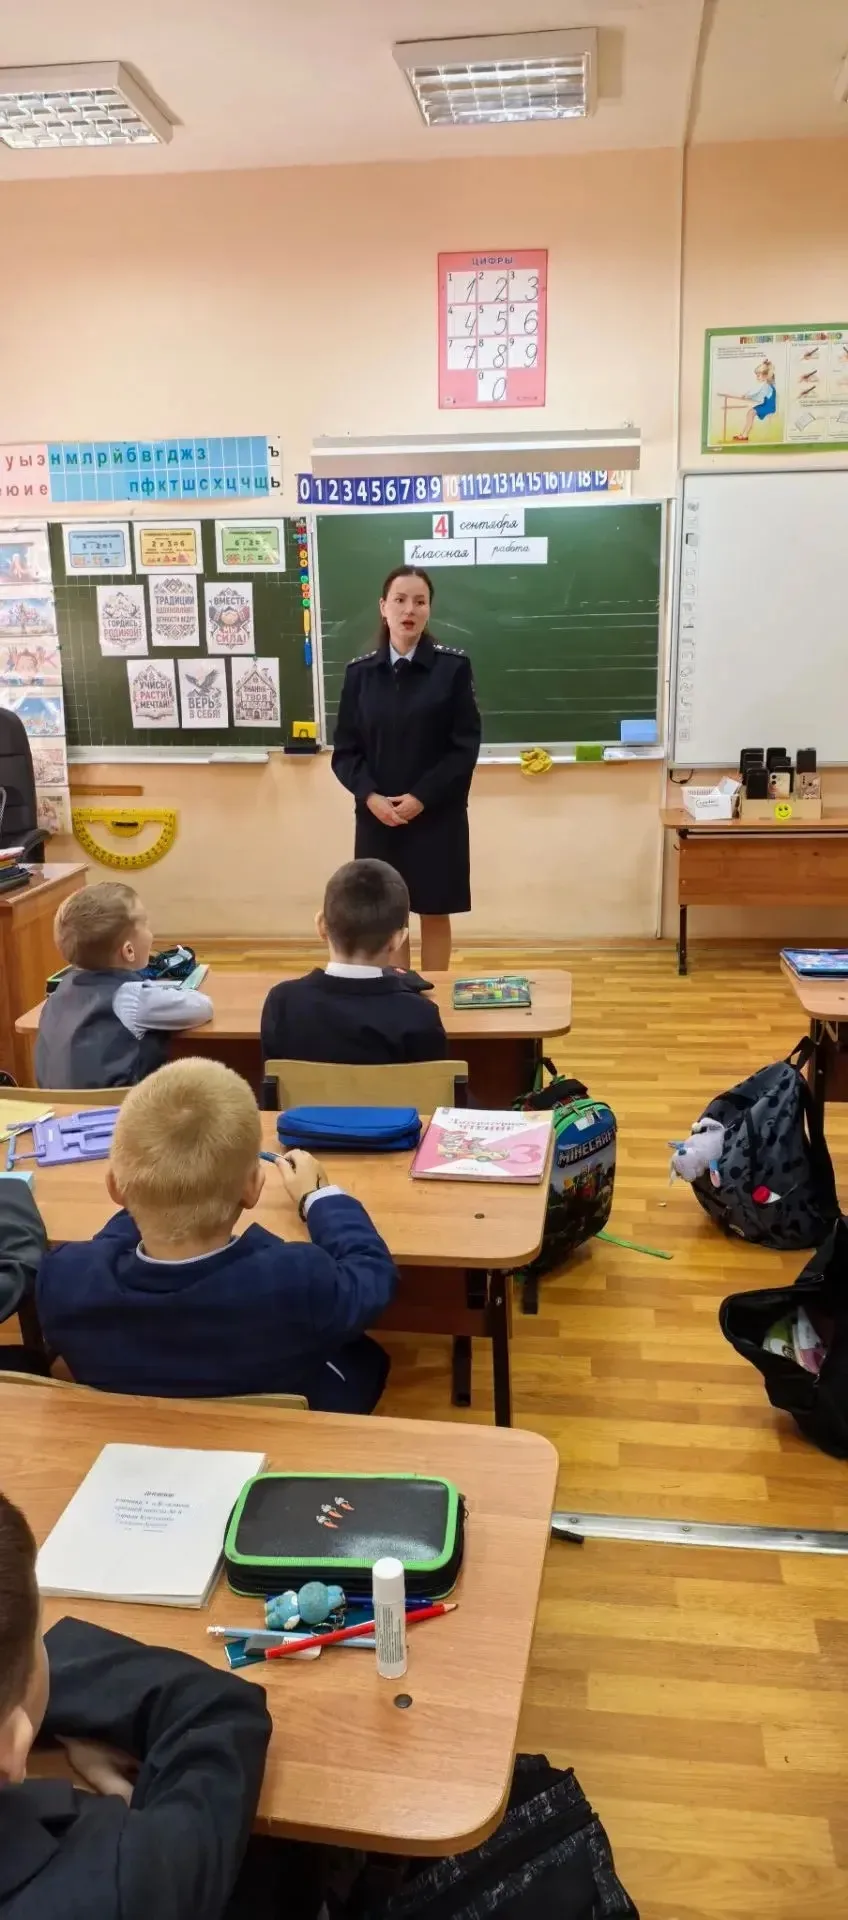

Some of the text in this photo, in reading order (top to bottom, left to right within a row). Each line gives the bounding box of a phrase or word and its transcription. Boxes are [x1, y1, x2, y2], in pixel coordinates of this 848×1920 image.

[472, 257, 513, 266] ЦИФРЫ
[467, 276, 539, 303] 1 2 3
[465, 310, 538, 336] 4 5 6
[464, 343, 538, 369] 7 8 9
[492, 377, 507, 401] 0
[300, 478, 310, 500] 0
[315, 479, 323, 501] 1
[328, 480, 339, 501] 2
[343, 480, 352, 502] 3
[357, 480, 368, 502] 4
[372, 480, 381, 502] 5
[385, 479, 396, 501] 6
[400, 478, 411, 500] 7
[415, 477, 427, 500] 8
[430, 476, 441, 499] 9
[444, 475, 458, 497] 10
[461, 473, 474, 496] 11
[477, 473, 491, 495] 12
[493, 473, 508, 494] 13
[510, 472, 524, 492] 14
[526, 471, 541, 491] 15
[543, 471, 558, 490] 16
[434, 513, 519, 538] 4 сентября
[411, 540, 530, 559] Классная работа
[155, 595, 195, 606] ТРАДИЦИИ
[214, 596, 245, 606] ВМЕСТЕ
[108, 619, 138, 629] ГОРДИСЬ
[188, 697, 215, 709] ВЕРЬ
[511, 1143, 542, 1165] 3
